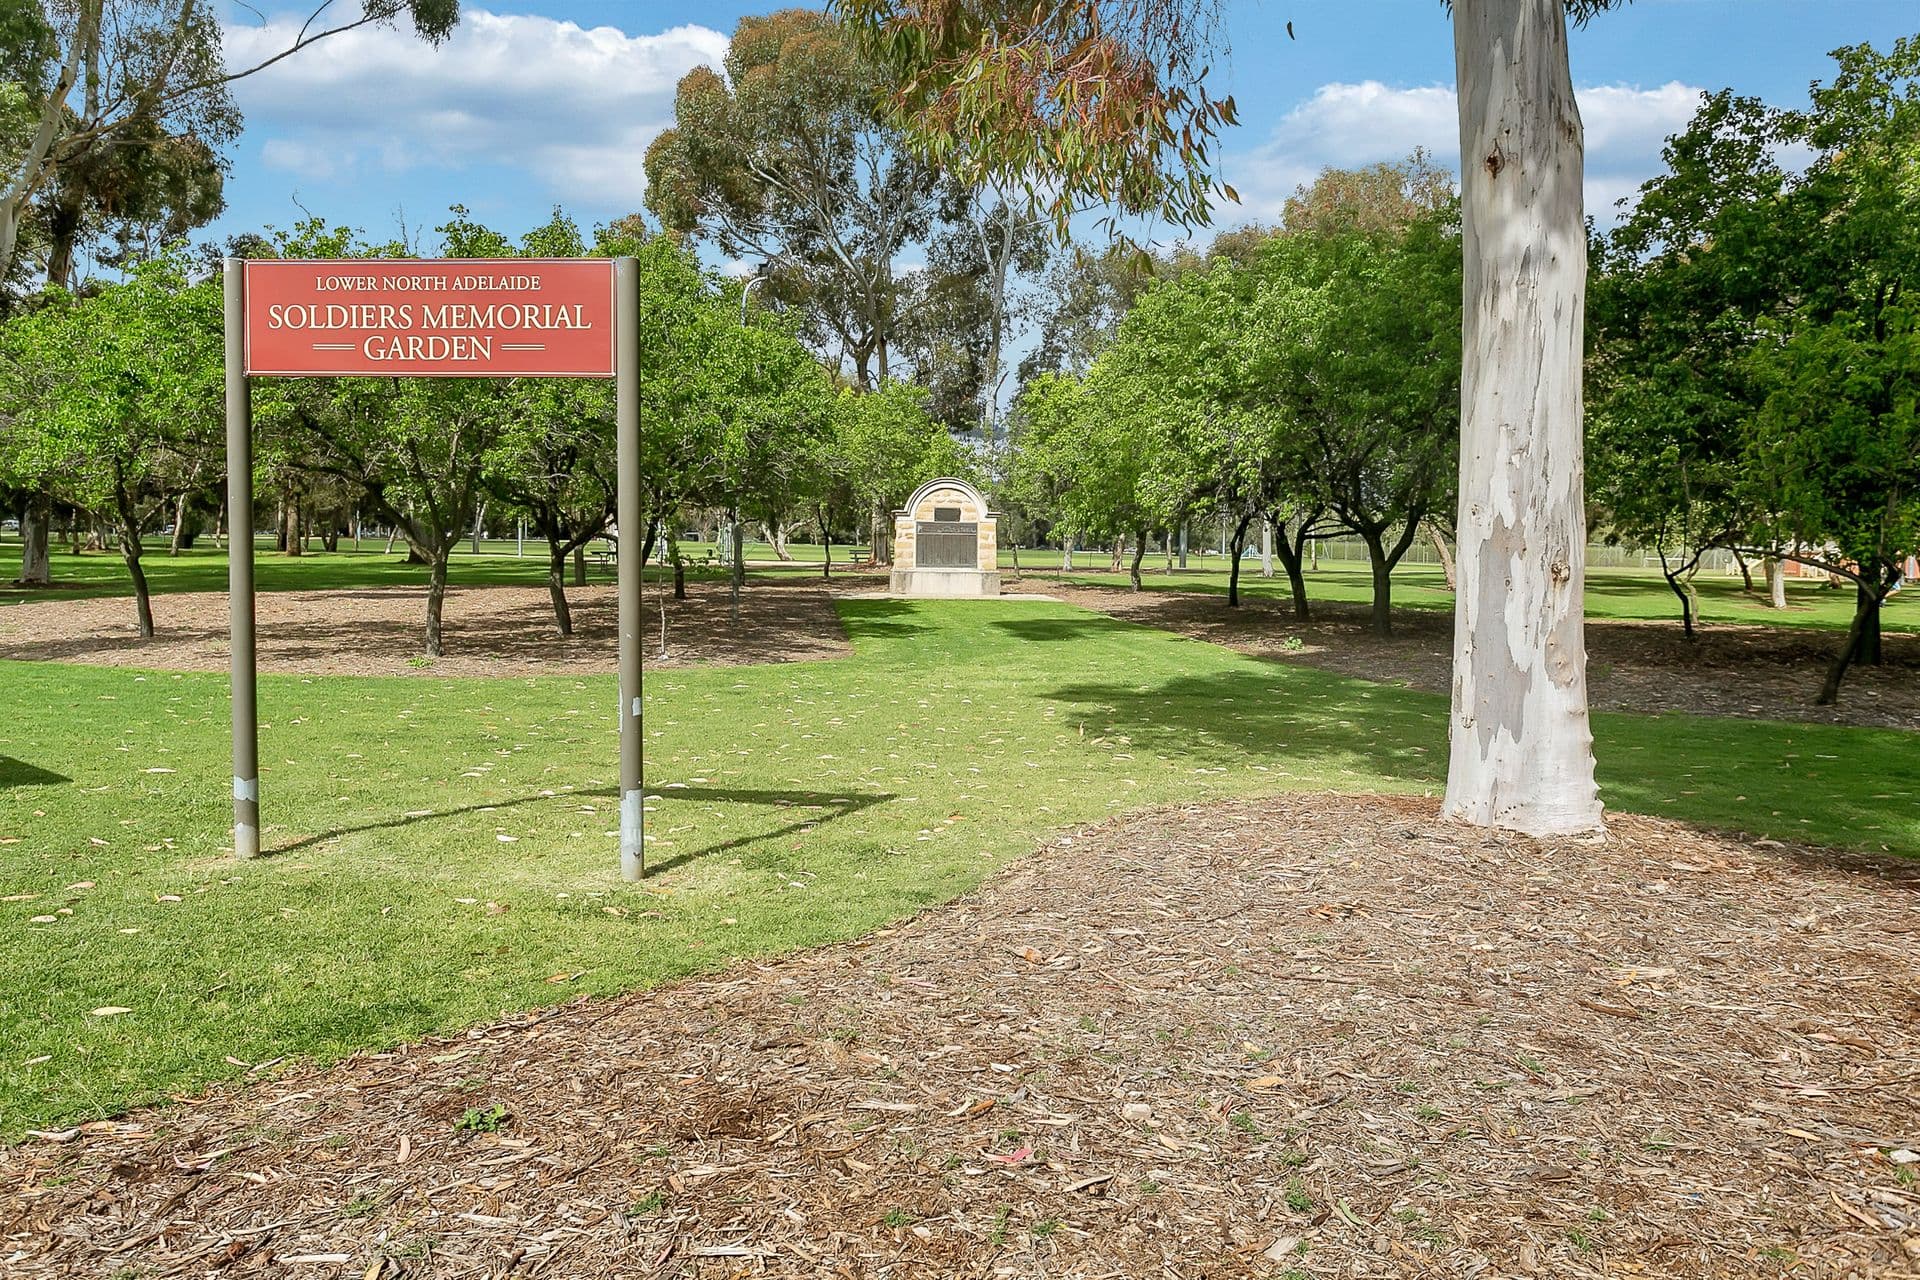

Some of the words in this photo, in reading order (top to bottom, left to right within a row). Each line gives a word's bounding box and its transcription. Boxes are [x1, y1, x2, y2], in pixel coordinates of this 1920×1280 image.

[315, 276, 379, 291] LOWER
[383, 276, 447, 291] NORTH
[452, 275, 541, 291] ADELAIDE
[268, 304, 413, 330] SOLDIERS
[421, 303, 592, 330] MEMORIAL
[363, 335, 493, 361] GARDEN
